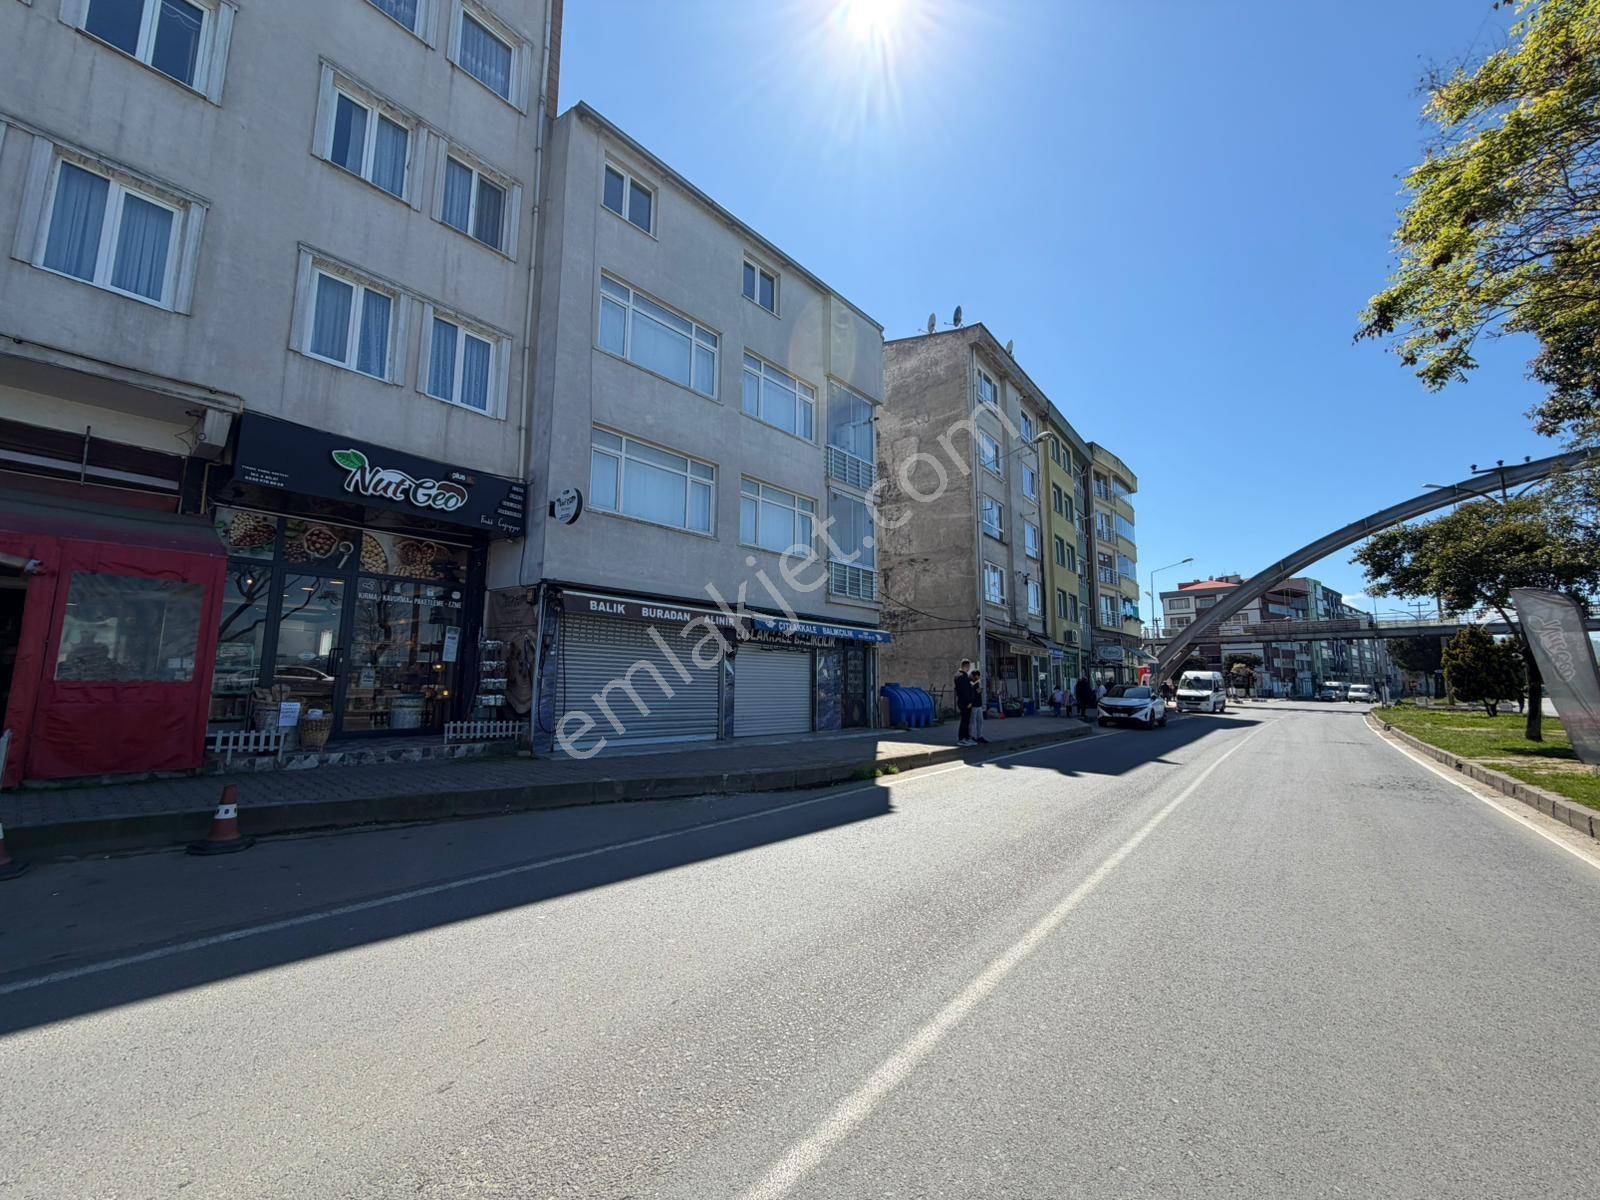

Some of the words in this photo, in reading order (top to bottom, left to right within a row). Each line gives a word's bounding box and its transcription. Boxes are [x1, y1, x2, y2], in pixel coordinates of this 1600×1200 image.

[343, 466, 406, 502] Nut
[408, 478, 468, 512] Geo
[589, 600, 626, 615] BALIK
[641, 607, 691, 622] BURADAN
